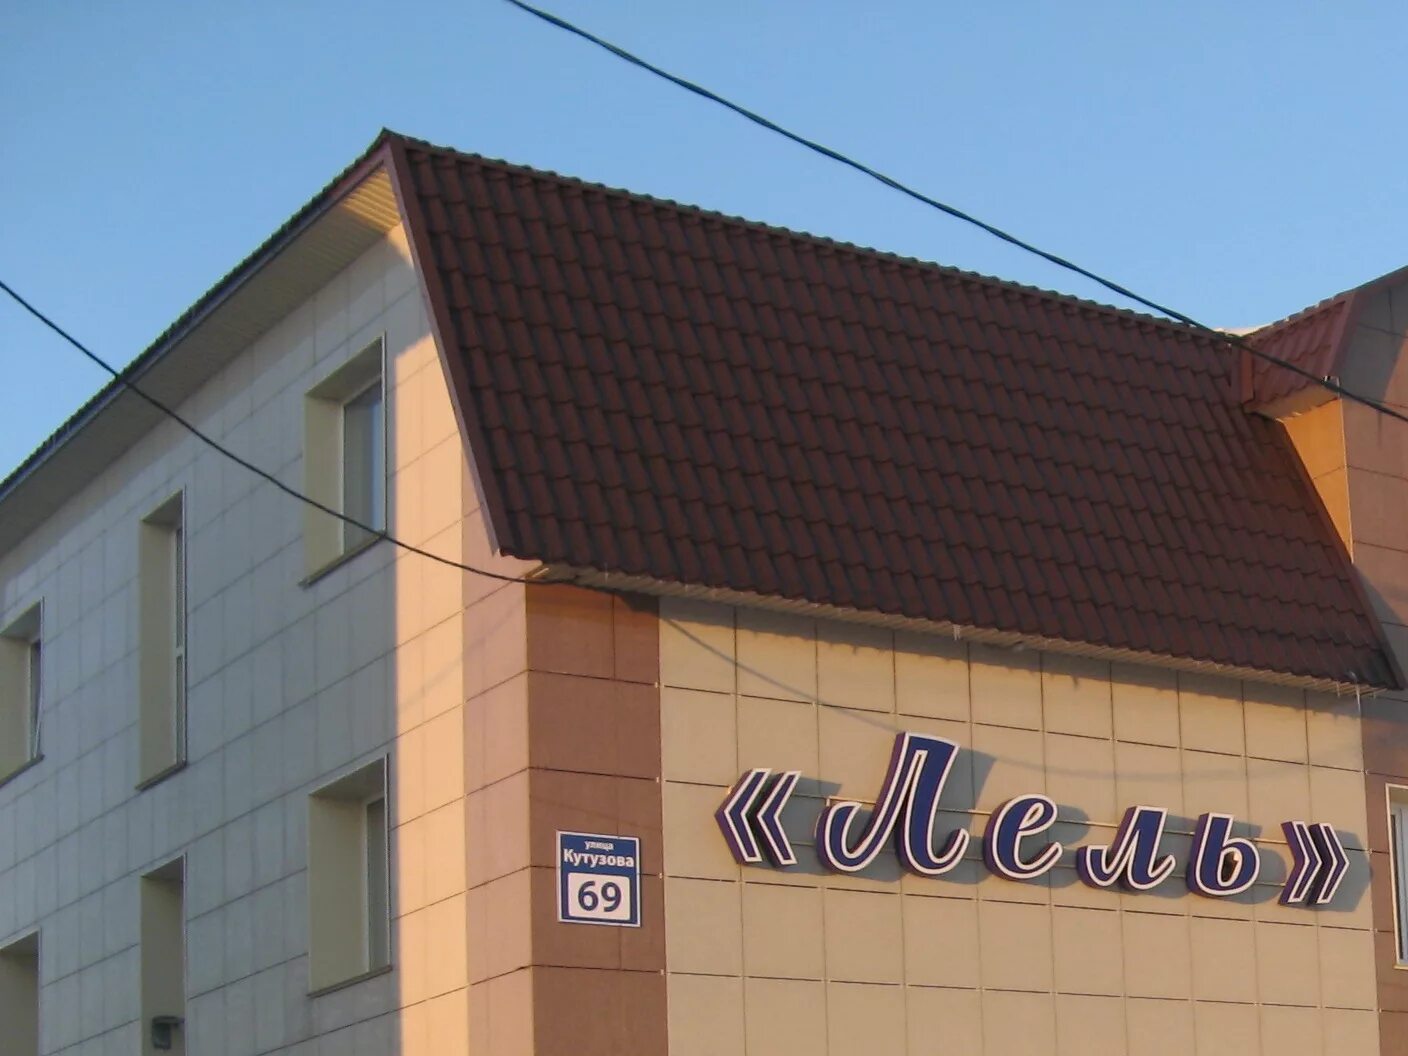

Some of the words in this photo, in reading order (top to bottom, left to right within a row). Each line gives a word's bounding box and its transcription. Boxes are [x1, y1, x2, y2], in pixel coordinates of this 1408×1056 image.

[714, 731, 1350, 906] «Лель»
[563, 848, 635, 868] Кутузова
[584, 841, 614, 851] улица
[578, 881, 622, 912] 69
